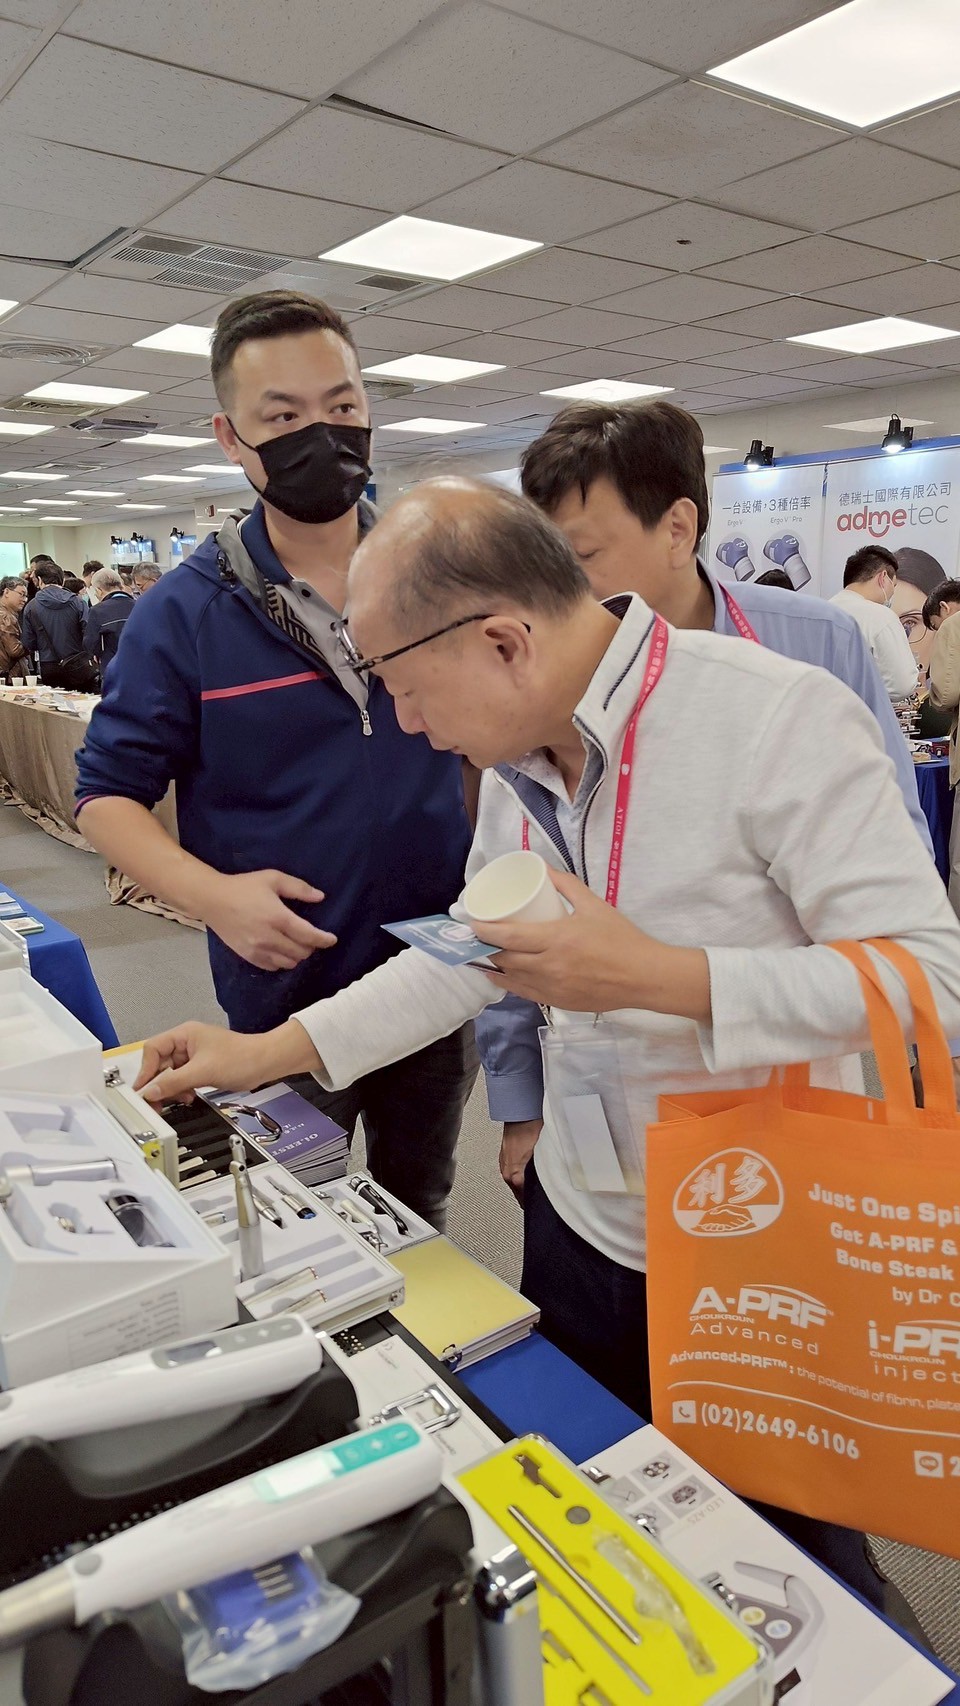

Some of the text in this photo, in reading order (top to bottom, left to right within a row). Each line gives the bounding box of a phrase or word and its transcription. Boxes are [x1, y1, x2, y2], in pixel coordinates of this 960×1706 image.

[839, 482, 952, 506] 德瑞士國際有限公司
[837, 503, 949, 538] admetec
[688, 1155, 767, 1208] 利多
[808, 1183, 856, 1212] Just
[861, 1196, 911, 1221] One
[830, 1221, 958, 1256] Get A-PRF &
[836, 1247, 954, 1281] Bone Steak
[892, 1286, 913, 1306] by
[918, 1288, 942, 1304] Dr
[690, 1322, 819, 1356] Advanced
[797, 1366, 816, 1380] the
[818, 1375, 870, 1400] potential
[871, 1391, 884, 1402] of
[701, 1402, 860, 1460] (02)2649-6106
